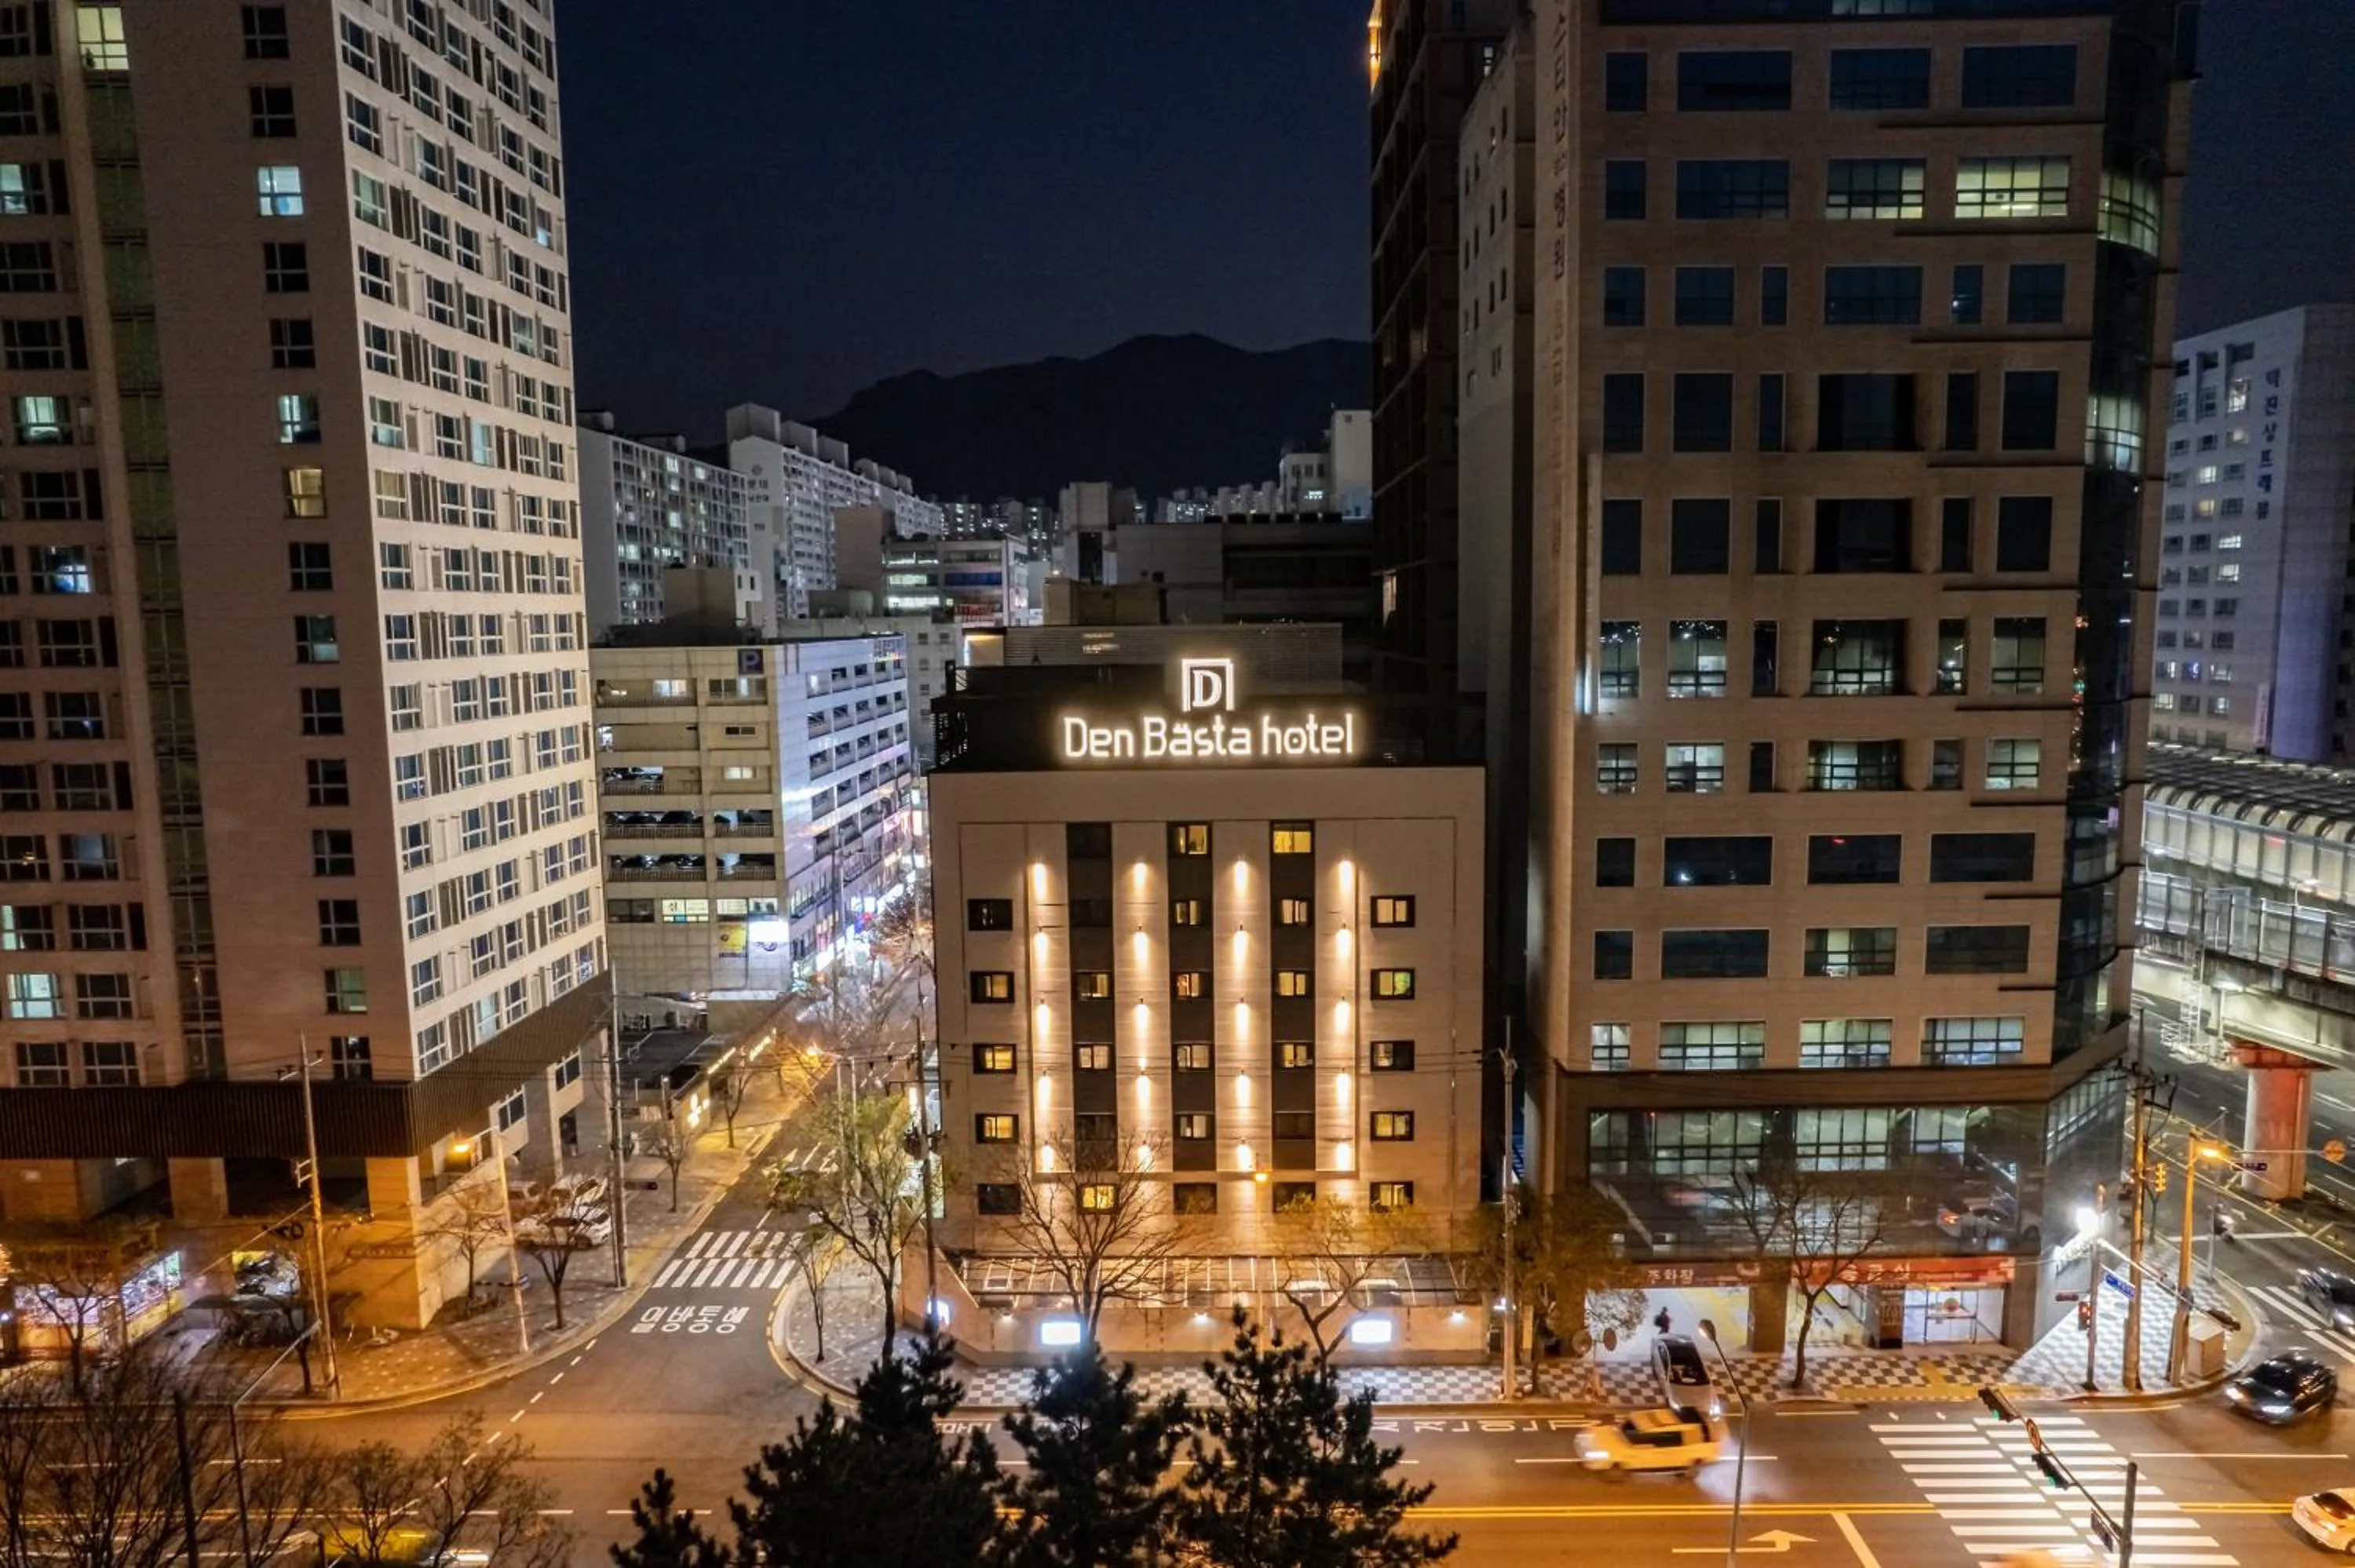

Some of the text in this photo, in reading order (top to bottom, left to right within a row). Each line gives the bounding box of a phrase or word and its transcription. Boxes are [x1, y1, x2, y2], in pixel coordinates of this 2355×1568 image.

[740, 651, 761, 671] P
[1064, 712, 1354, 758] Den Bästa hotel
[630, 1304, 750, 1334] 일방통행
